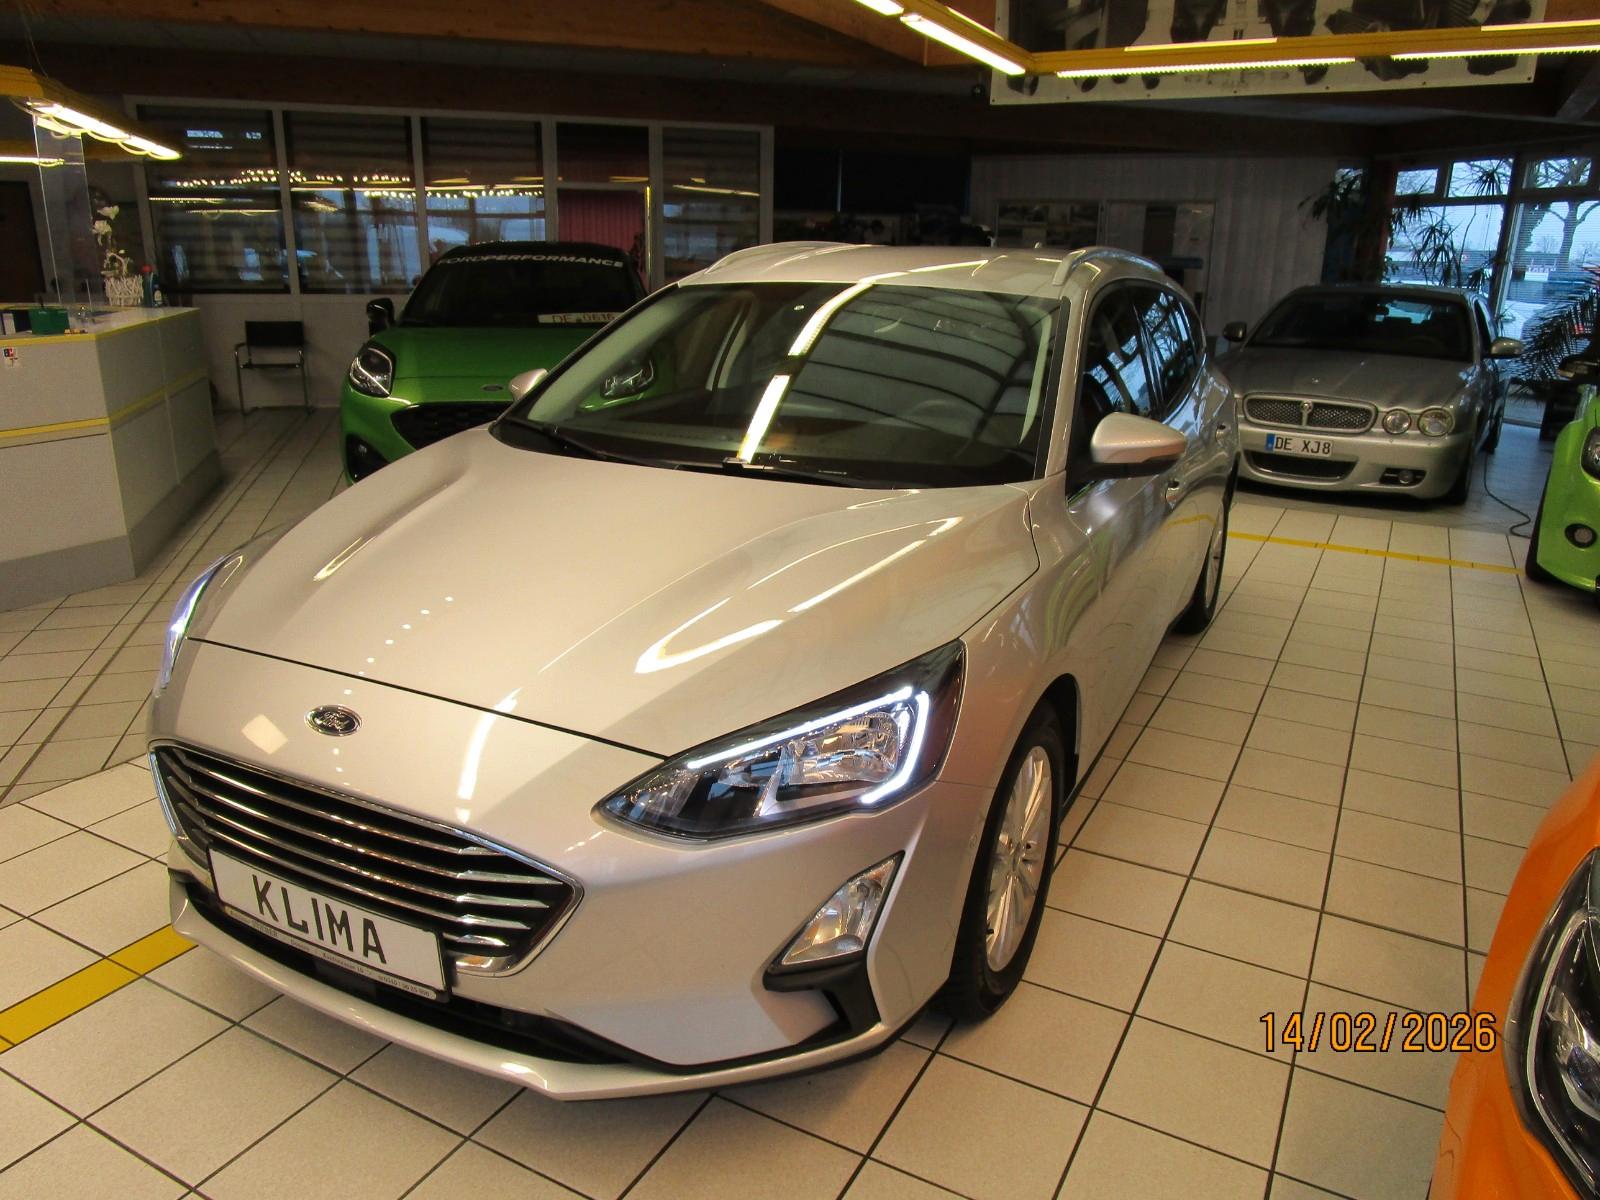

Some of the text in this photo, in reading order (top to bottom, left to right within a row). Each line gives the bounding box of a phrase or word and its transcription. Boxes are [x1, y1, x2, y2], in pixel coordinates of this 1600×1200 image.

[1274, 436, 1331, 455] DE XJ8
[252, 874, 387, 964] KLIMA
